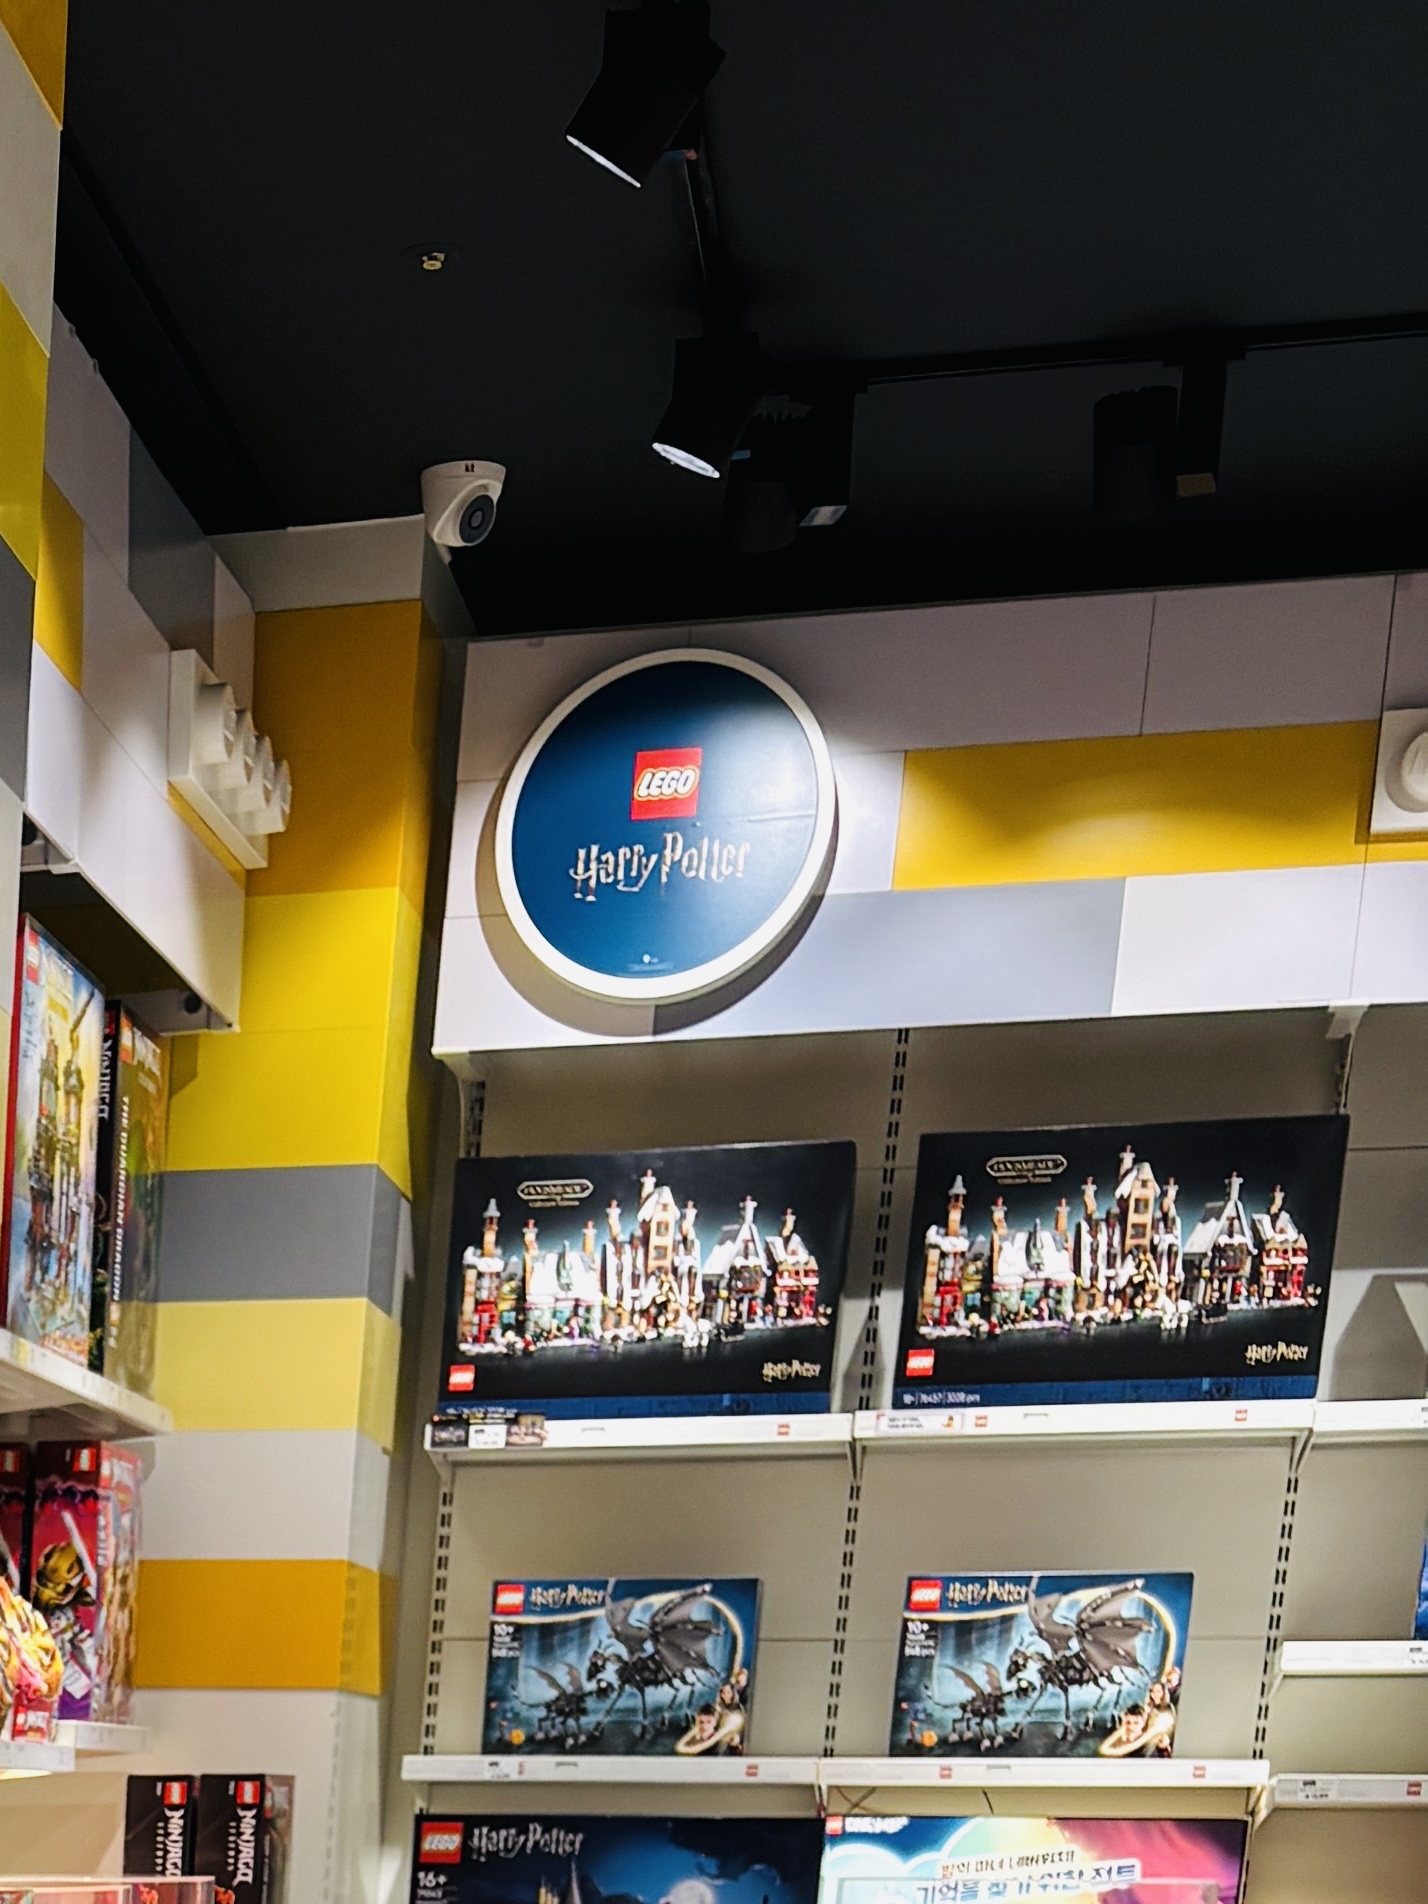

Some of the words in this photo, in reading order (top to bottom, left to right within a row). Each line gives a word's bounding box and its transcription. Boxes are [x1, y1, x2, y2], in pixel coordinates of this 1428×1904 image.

[637, 770, 698, 796] LEGO
[569, 845, 658, 902] Harry
[662, 831, 750, 895] Potter
[469, 1826, 526, 1860] Harry
[526, 1823, 584, 1855] Potter
[417, 1872, 447, 1886] 16+
